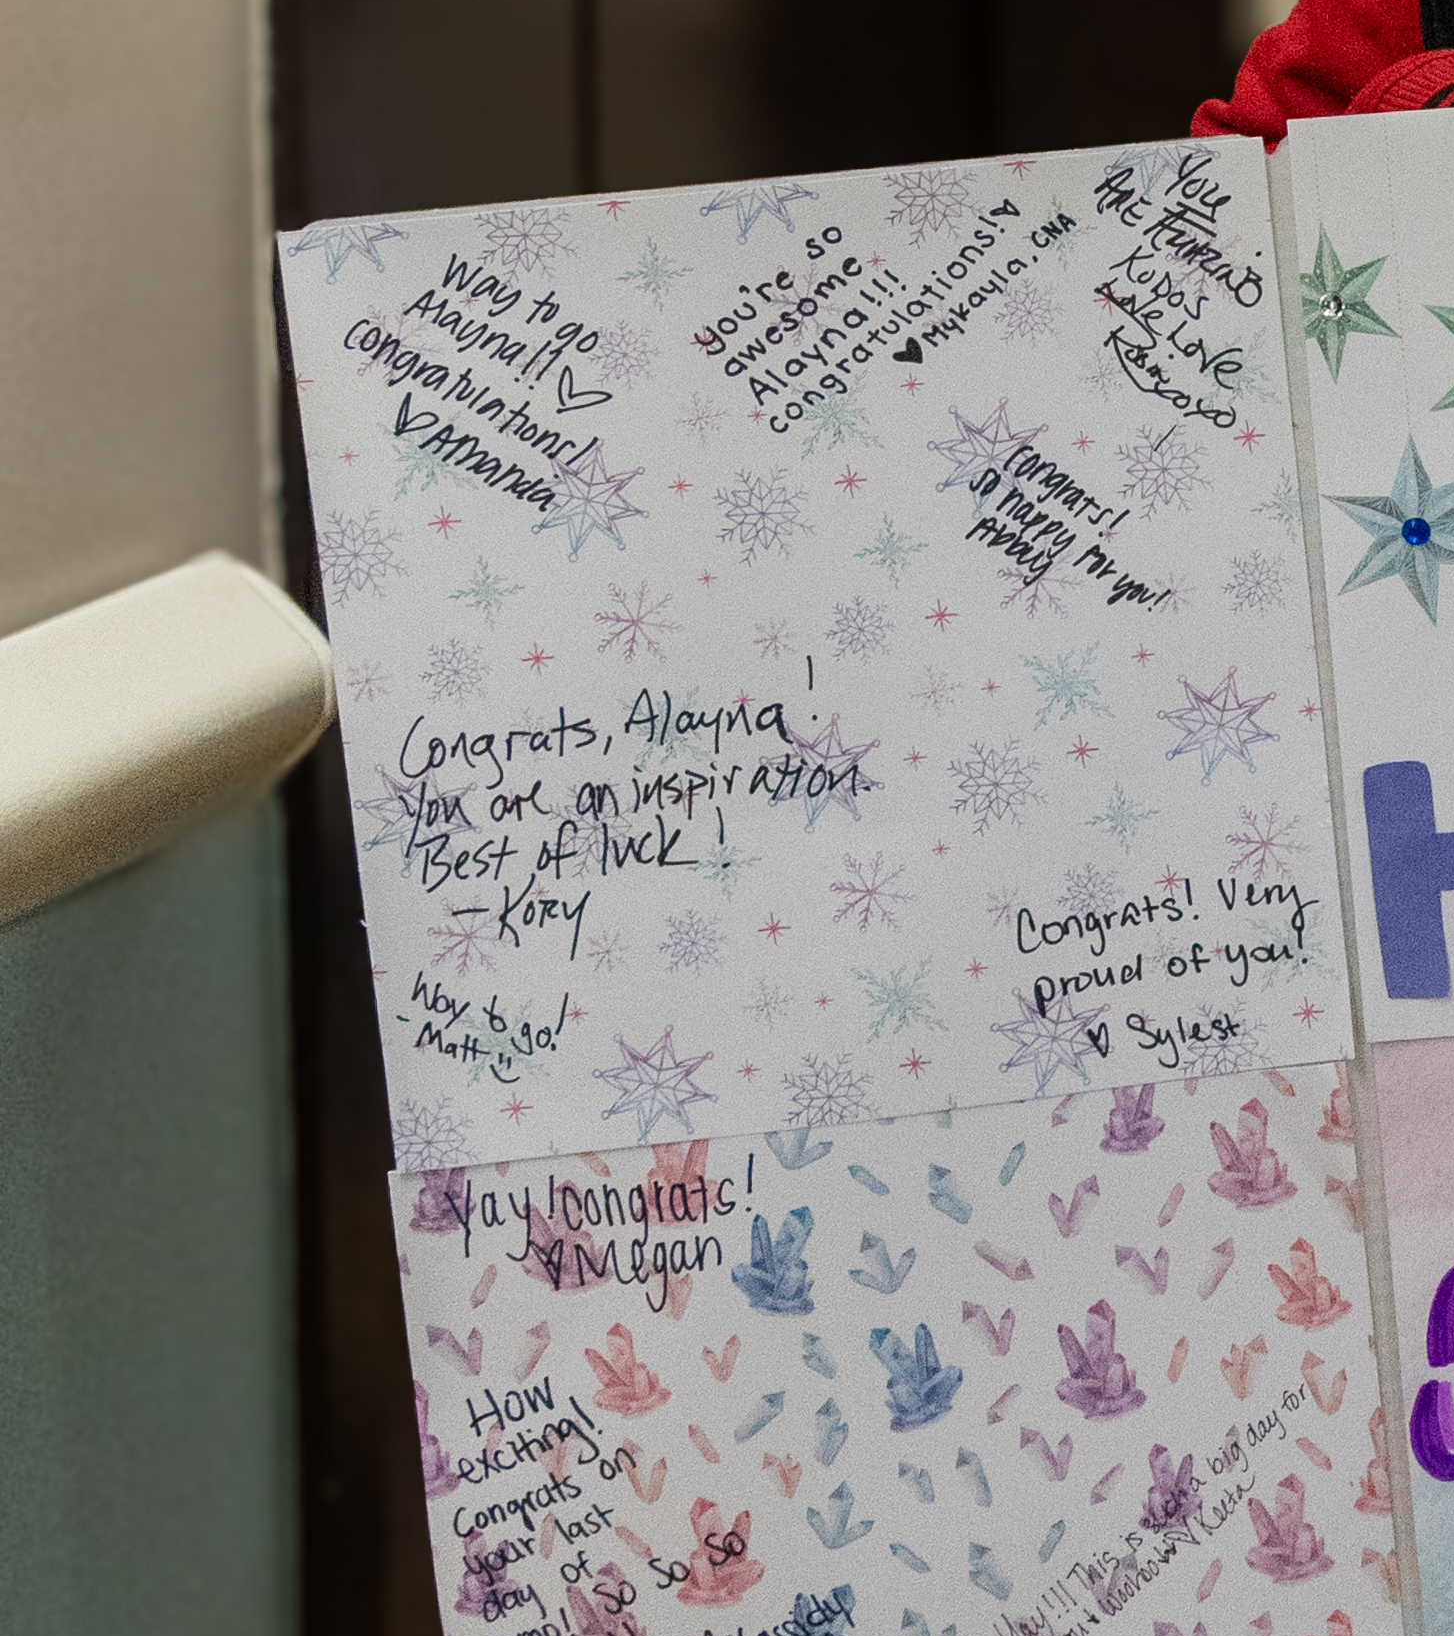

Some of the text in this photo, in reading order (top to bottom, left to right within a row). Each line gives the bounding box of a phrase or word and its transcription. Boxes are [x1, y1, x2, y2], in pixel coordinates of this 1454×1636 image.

[805, 226, 843, 261] so
[1031, 212, 1078, 249] CNA
[442, 253, 599, 354] Way to go
[724, 256, 864, 378] awesome
[996, 480, 1075, 556] happy
[400, 655, 819, 787] Congrats, Alayna!
[401, 781, 618, 857] You are an
[414, 807, 729, 892] Best of luck!
[1016, 878, 1319, 956] Congrats! Very
[412, 972, 567, 1054] Way go!
[1034, 930, 1309, 1017] proud of you!
[415, 1023, 490, 1061] Matt
[444, 1175, 555, 1261] Yay!
[577, 1236, 722, 1312] Megan
[458, 1396, 602, 1484] exciting!
[466, 1377, 554, 1437] How
[454, 1447, 636, 1538] Congrats on
[1067, 1550, 1120, 1589] This
[1206, 1441, 1249, 1475] big
[1246, 1409, 1286, 1446] day
[1281, 1383, 1307, 1412] for
[464, 1504, 615, 1586] your last
[482, 1552, 594, 1622] day of
